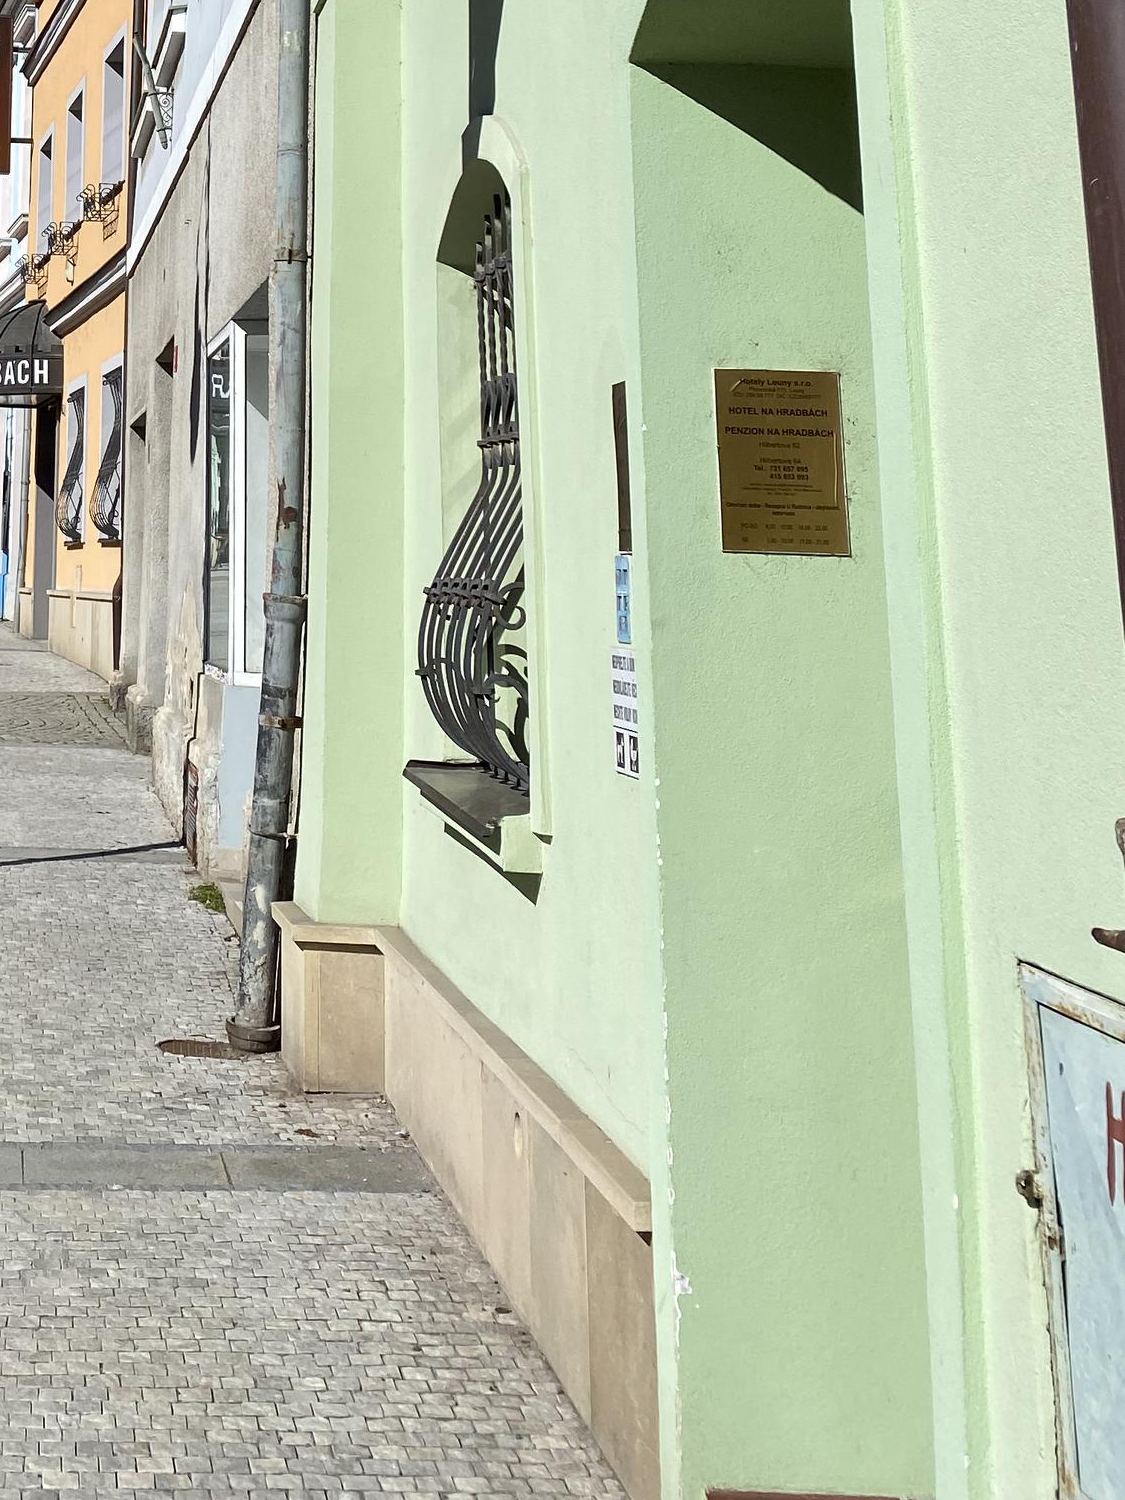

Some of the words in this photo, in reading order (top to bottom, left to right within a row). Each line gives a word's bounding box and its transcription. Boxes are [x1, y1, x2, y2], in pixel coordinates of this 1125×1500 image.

[767, 379, 791, 387] Louny
[728, 407, 759, 415] HOTEL
[761, 407, 774, 415] NA
[776, 408, 828, 417] HRADBÁCH
[724, 426, 765, 435] PENZION
[767, 428, 780, 436] NA
[782, 428, 834, 437] HRADBÁCH
